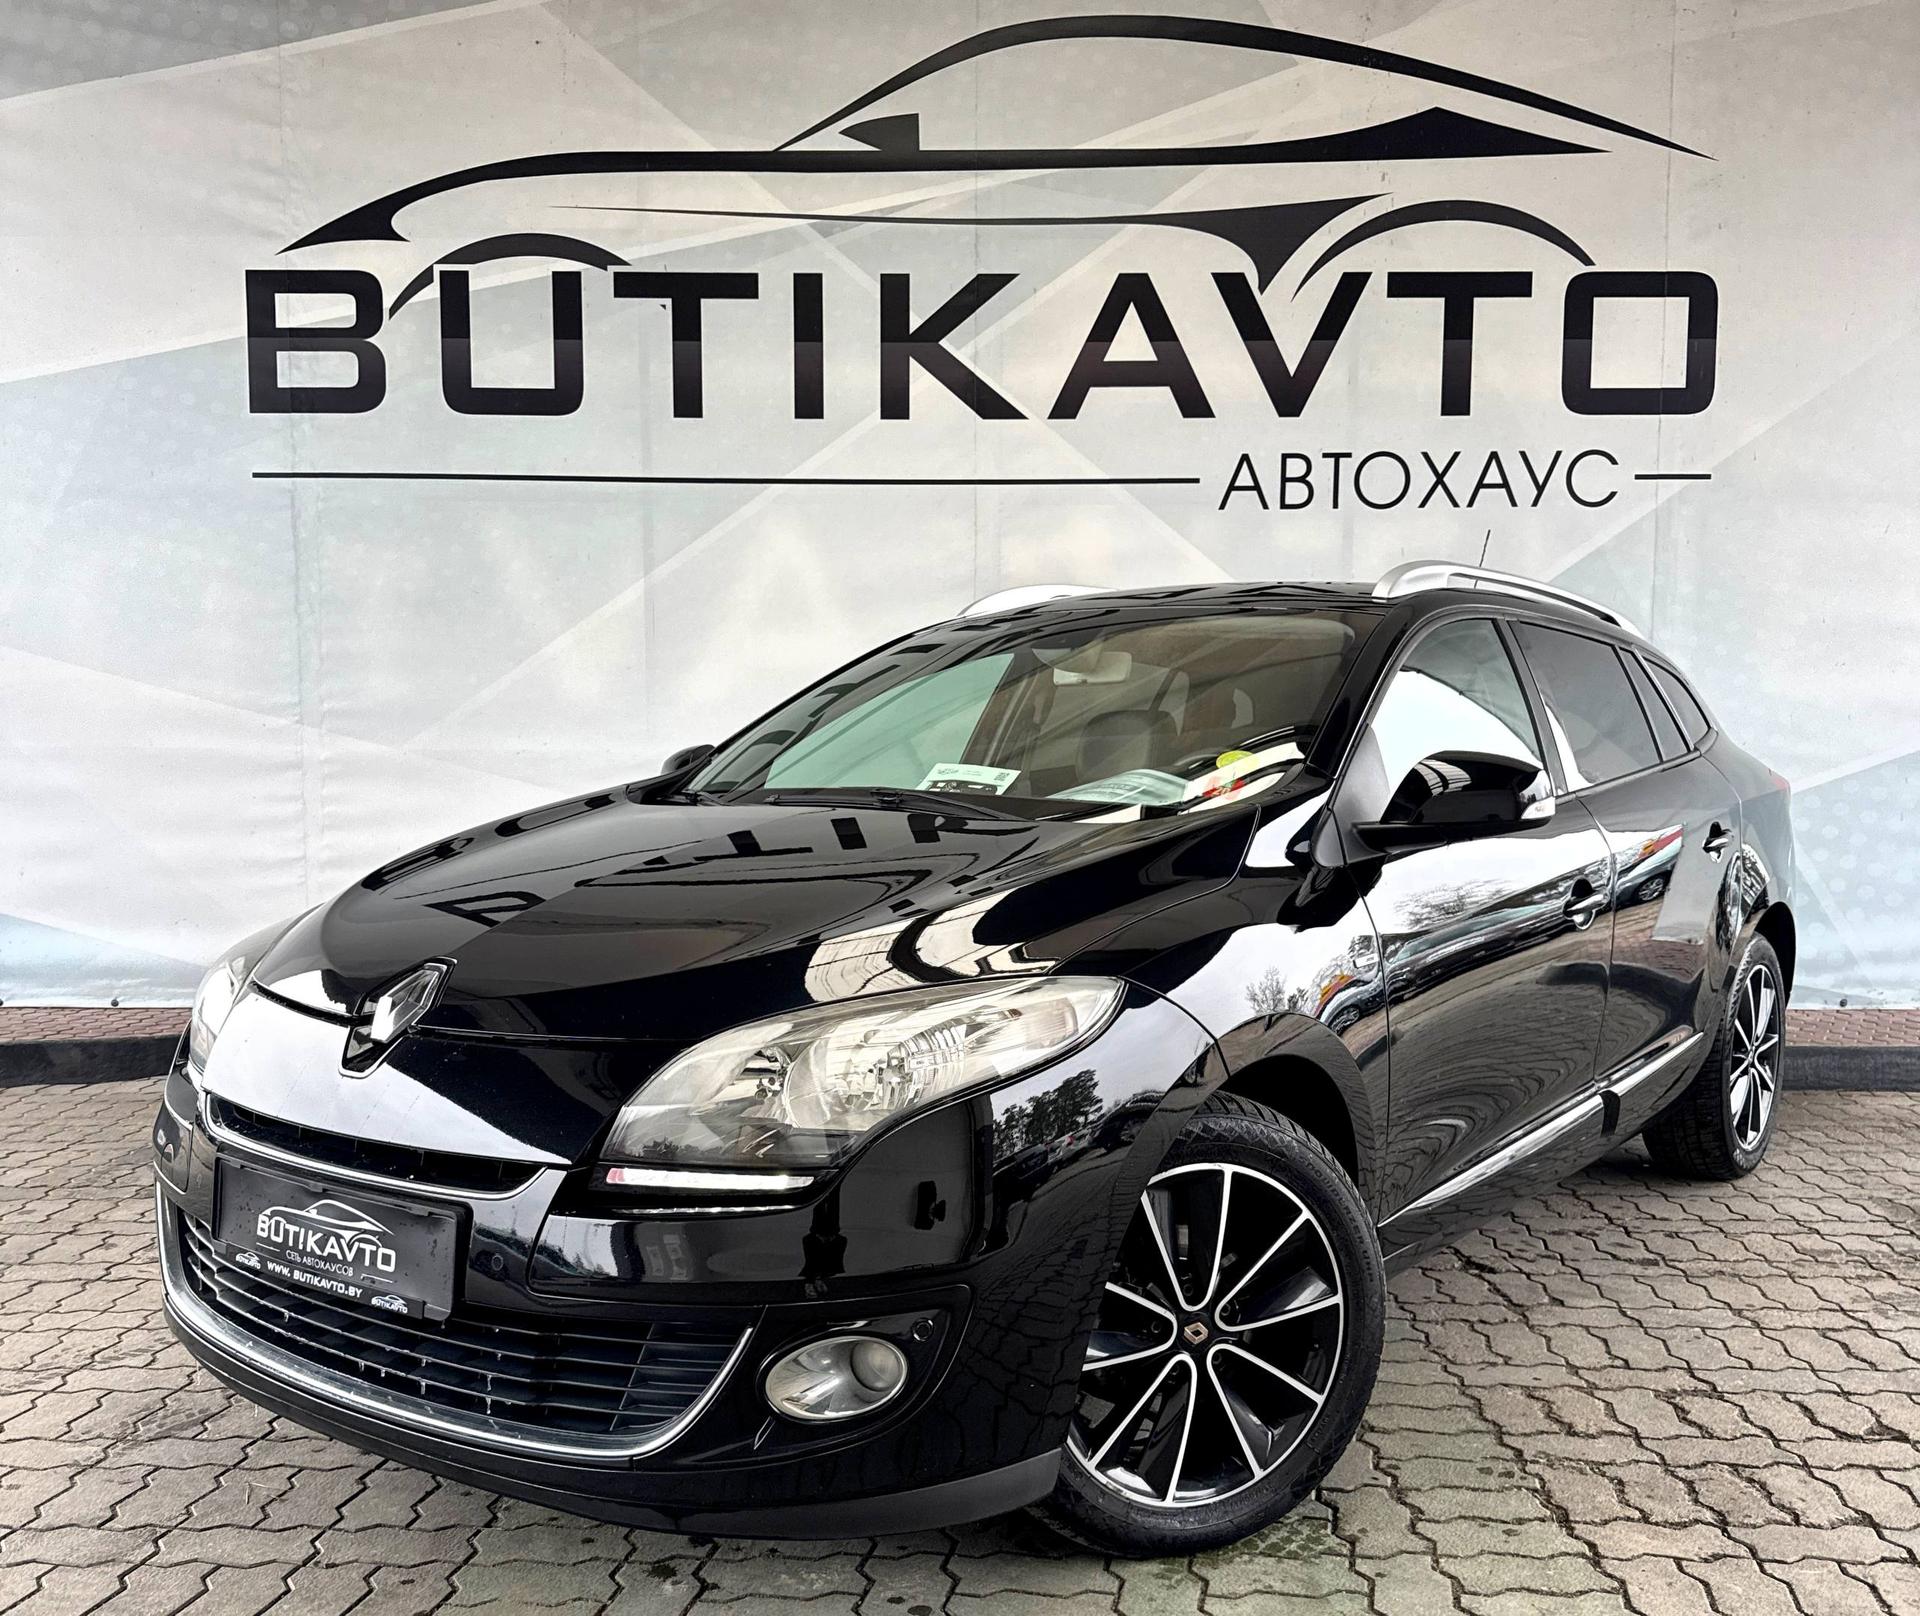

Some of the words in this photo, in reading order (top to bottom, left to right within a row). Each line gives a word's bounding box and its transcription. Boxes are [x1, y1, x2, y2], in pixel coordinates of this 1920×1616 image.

[246, 269, 1719, 420] BUTIKAVTO
[1218, 449, 1619, 511] АВТОХАУС
[257, 1213, 396, 1273] BUTIKAVTO
[285, 1249, 301, 1263] СЕТЬ
[302, 1255, 354, 1277] АВТОХАУСОВ
[293, 1269, 363, 1298] BUTIKAVTO.BY
